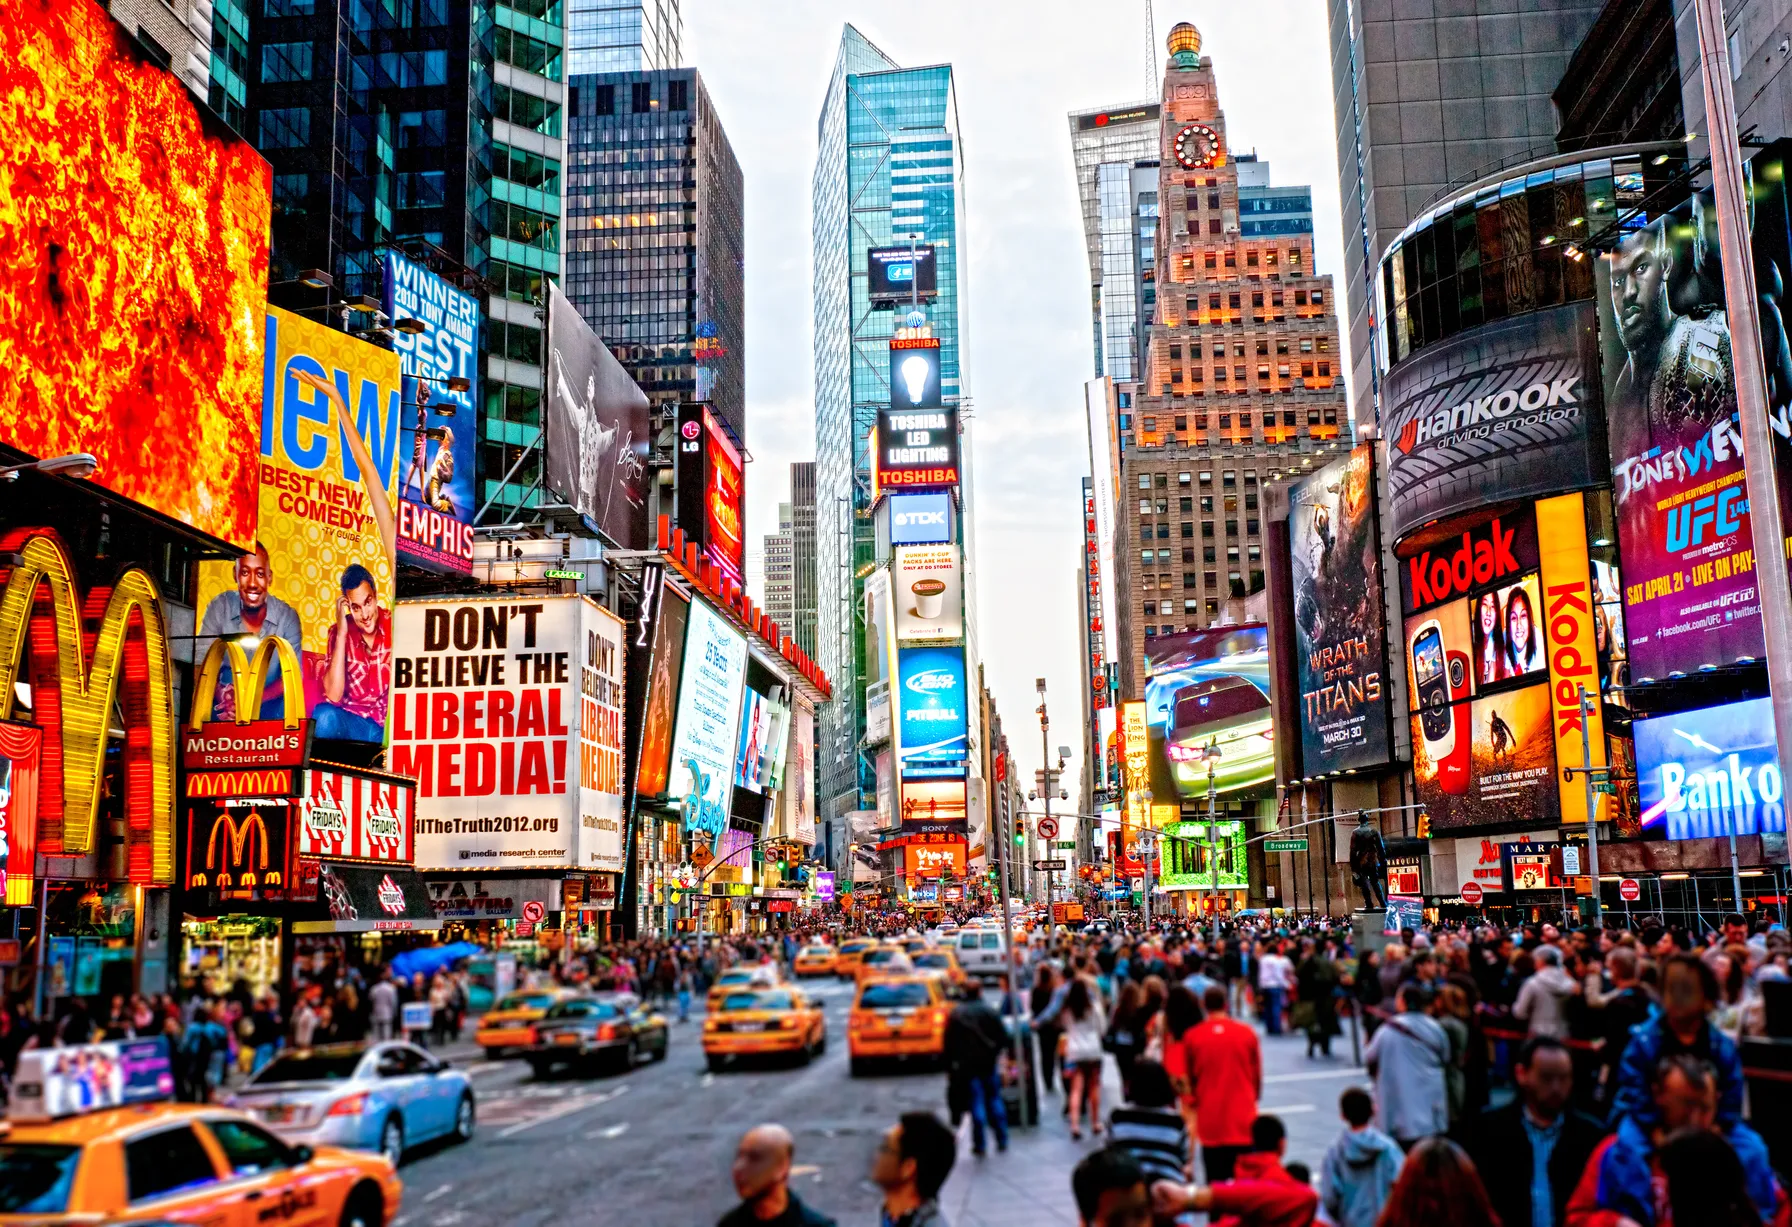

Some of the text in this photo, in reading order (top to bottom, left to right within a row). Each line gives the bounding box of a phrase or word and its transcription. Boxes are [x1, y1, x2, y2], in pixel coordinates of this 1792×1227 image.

[391, 253, 477, 326] WINNER!
[395, 285, 473, 343] 2010 TONY AWARD
[393, 305, 473, 378] BEST
[898, 328, 931, 339] 2012
[890, 340, 939, 348] TOSHIBA
[890, 414, 947, 430] TOSHIBA
[1437, 407, 1579, 450] driving emotion
[682, 442, 699, 452] LG
[907, 431, 930, 446] LED
[890, 448, 948, 464] LIGHTING
[880, 470, 957, 483] TOSHIBA
[1614, 431, 1714, 504] JONES VS
[261, 464, 364, 511] BEST NEW
[1657, 498, 1672, 511] WORLD
[1673, 493, 1685, 505] LIGHT
[1685, 481, 1716, 500] HEAVYWEIGHT
[905, 511, 945, 524] TDK
[1666, 486, 1742, 553] UFC
[337, 530, 360, 543] GUIDE
[1410, 518, 1520, 609] Kodak
[548, 570, 582, 579] LAMAR
[1627, 583, 1643, 606] SAT
[1645, 572, 1671, 600] APRIL
[1673, 570, 1683, 593] 21
[1692, 560, 1714, 587] LIVE
[1715, 555, 1731, 579] ON
[424, 604, 543, 651] DON'T
[1662, 614, 1721, 637] facebook.com/UFC
[589, 629, 615, 677] DON'T
[1310, 635, 1368, 672] WRATH
[1547, 581, 1597, 738] Kodak
[395, 652, 568, 688] BELIEVE THE
[920, 674, 954, 683] BUD
[1324, 664, 1354, 682] OF THE
[582, 666, 620, 709] BELIEVE THE
[916, 680, 957, 689] LIGHT
[1303, 672, 1381, 724] TITANS
[393, 688, 568, 740] LIBERAL
[581, 698, 620, 749] LIBERAL
[906, 709, 959, 721] PITBULL
[1128, 725, 1143, 733] LION
[1128, 733, 1145, 742] KING
[1324, 729, 1350, 744] MARCH
[1351, 726, 1361, 737] 30
[187, 735, 299, 753] McDonald's
[204, 753, 279, 764] Restaurant
[392, 740, 567, 797] MEDIA!
[581, 742, 620, 795] MEDIA!
[1480, 767, 1548, 785] BUILT FOR THE WAY YOU PLAY.
[1661, 753, 1756, 812] Bank
[471, 849, 497, 857] media
[499, 849, 535, 857] research
[538, 849, 566, 857] center
[1387, 857, 1419, 865] MARQUIS
[431, 897, 513, 910] COMPUTERS
